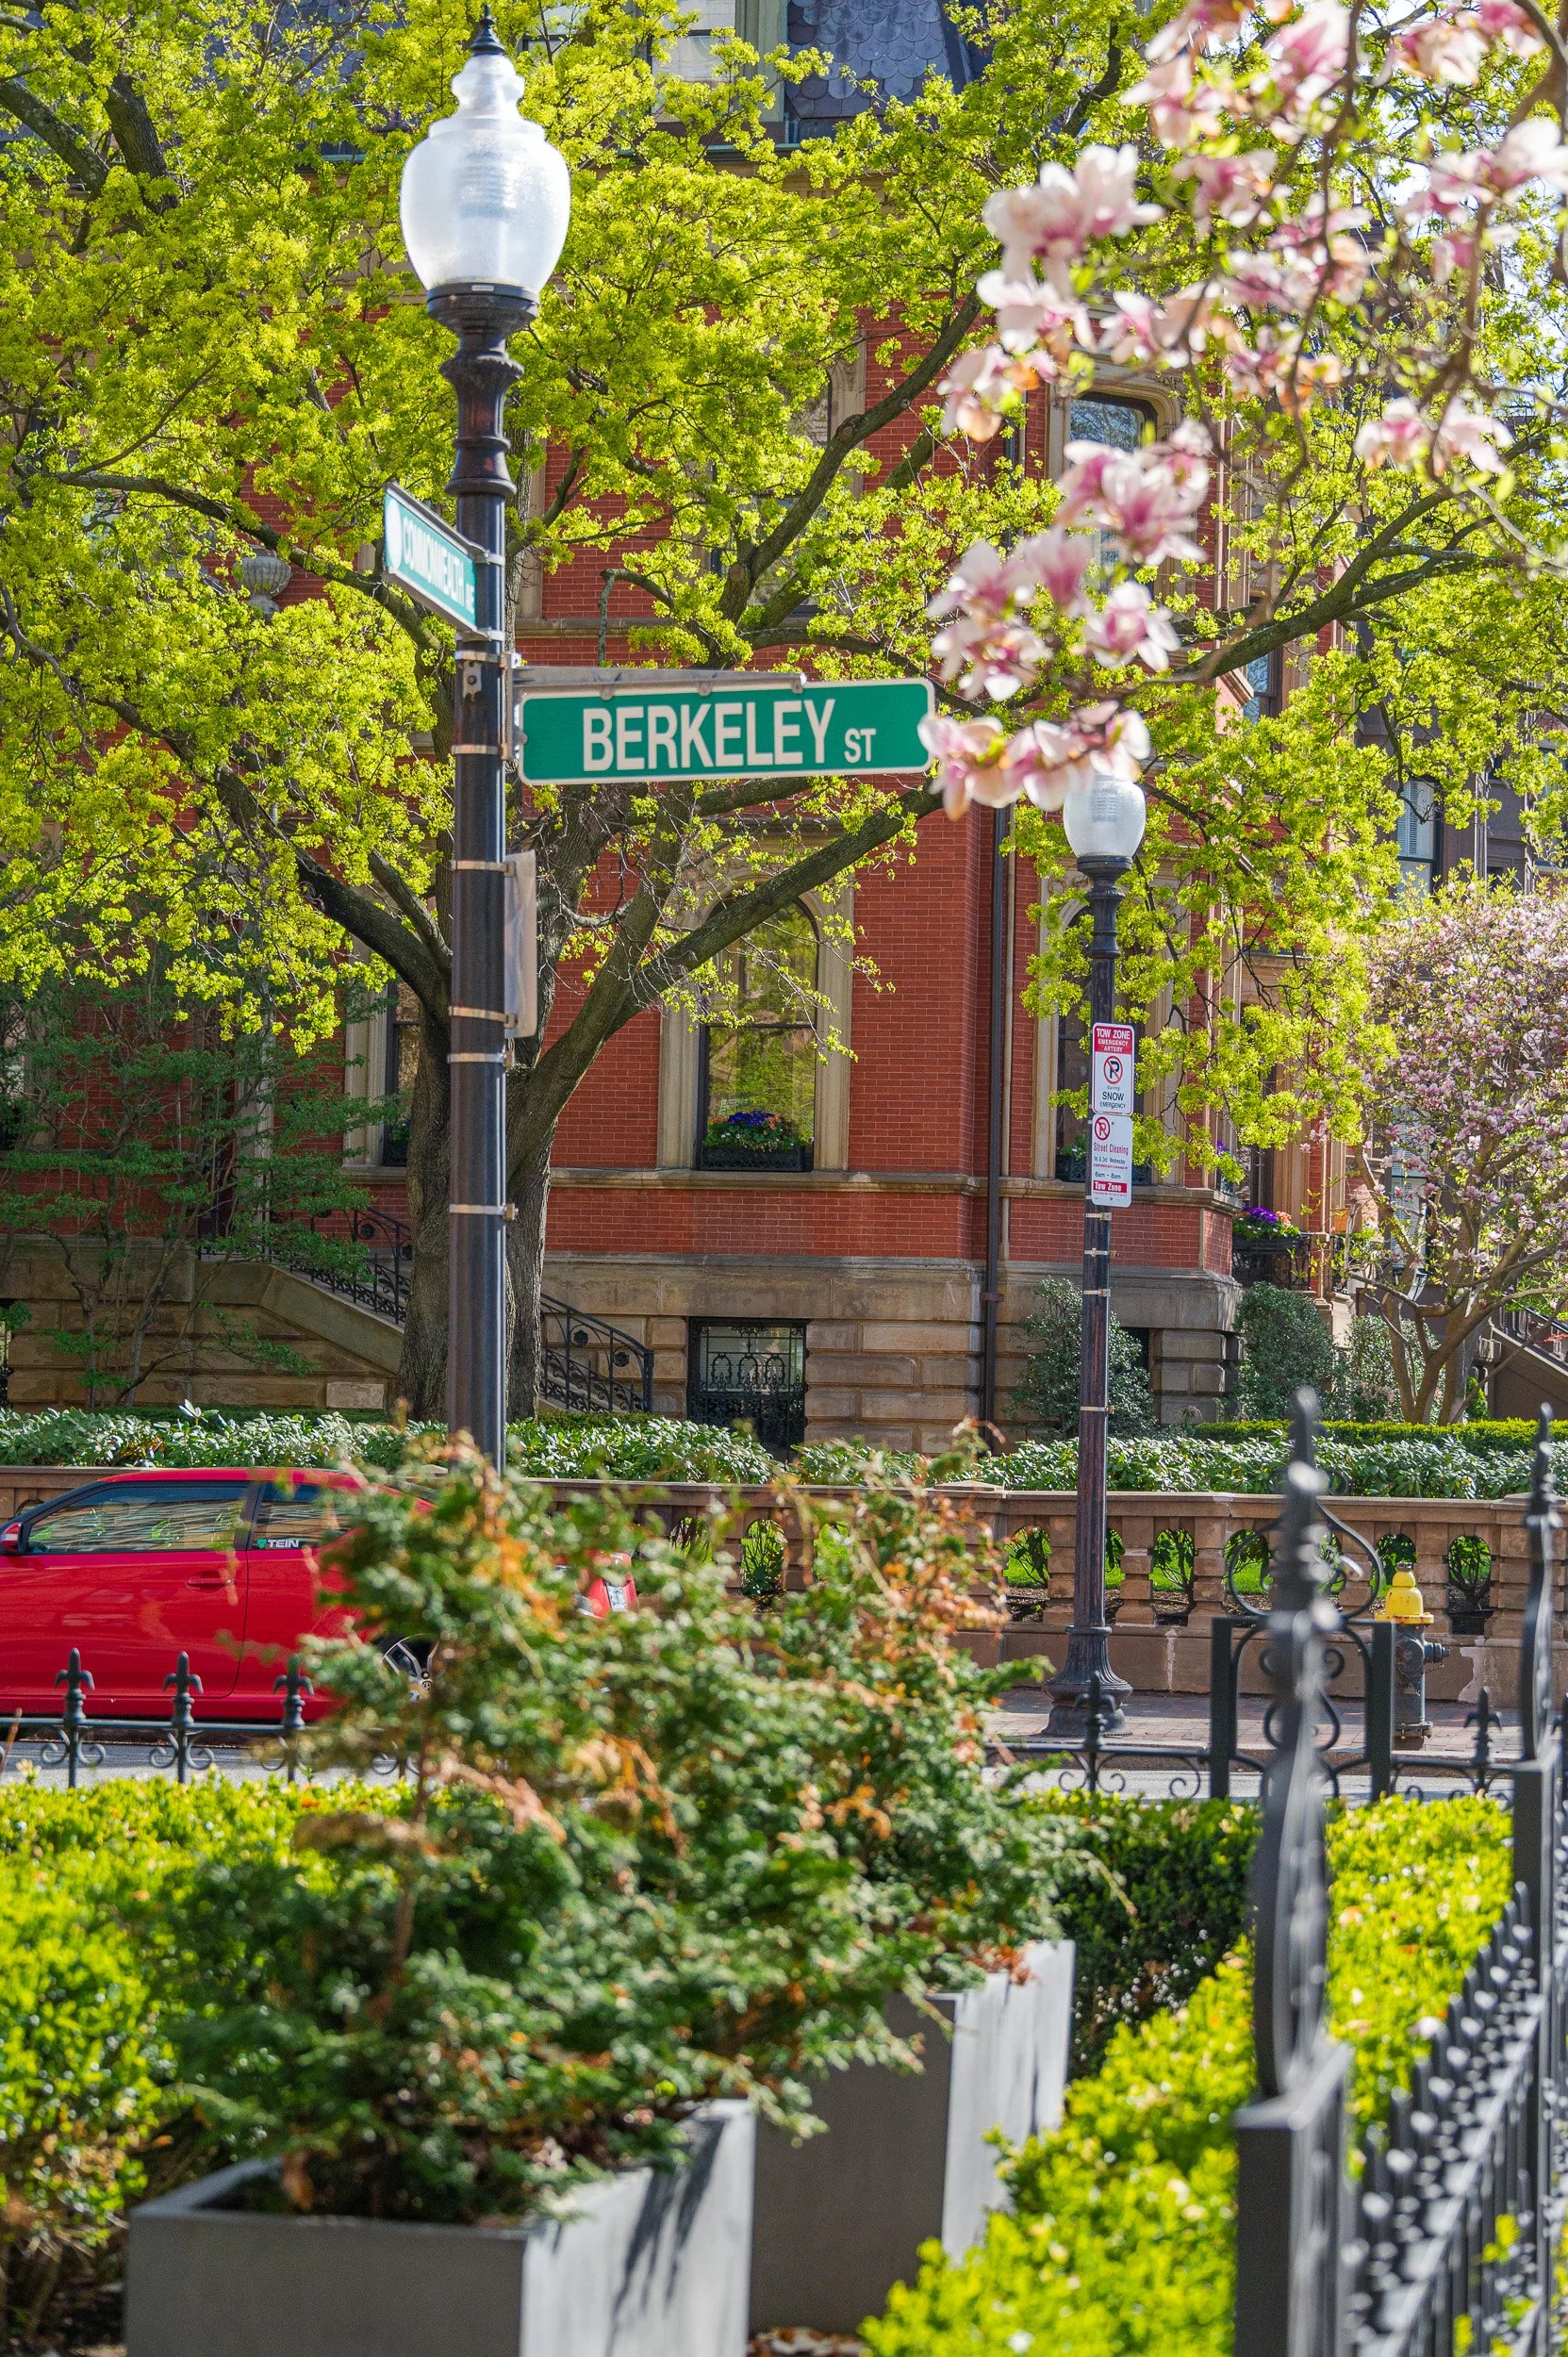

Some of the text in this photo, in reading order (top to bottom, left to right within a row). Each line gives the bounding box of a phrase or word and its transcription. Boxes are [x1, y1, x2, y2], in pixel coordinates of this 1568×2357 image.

[583, 699, 876, 772] BERKELEY ST
[1096, 1029, 1131, 1040] TOW ZONE
[1098, 1038, 1129, 1047] EMERGENCY
[1102, 1091, 1125, 1101] SNOW
[1094, 1142, 1129, 1156] Street Cleaning
[1095, 1181, 1122, 1192] Tow Zone
[268, 1539, 300, 1548] TEIN
